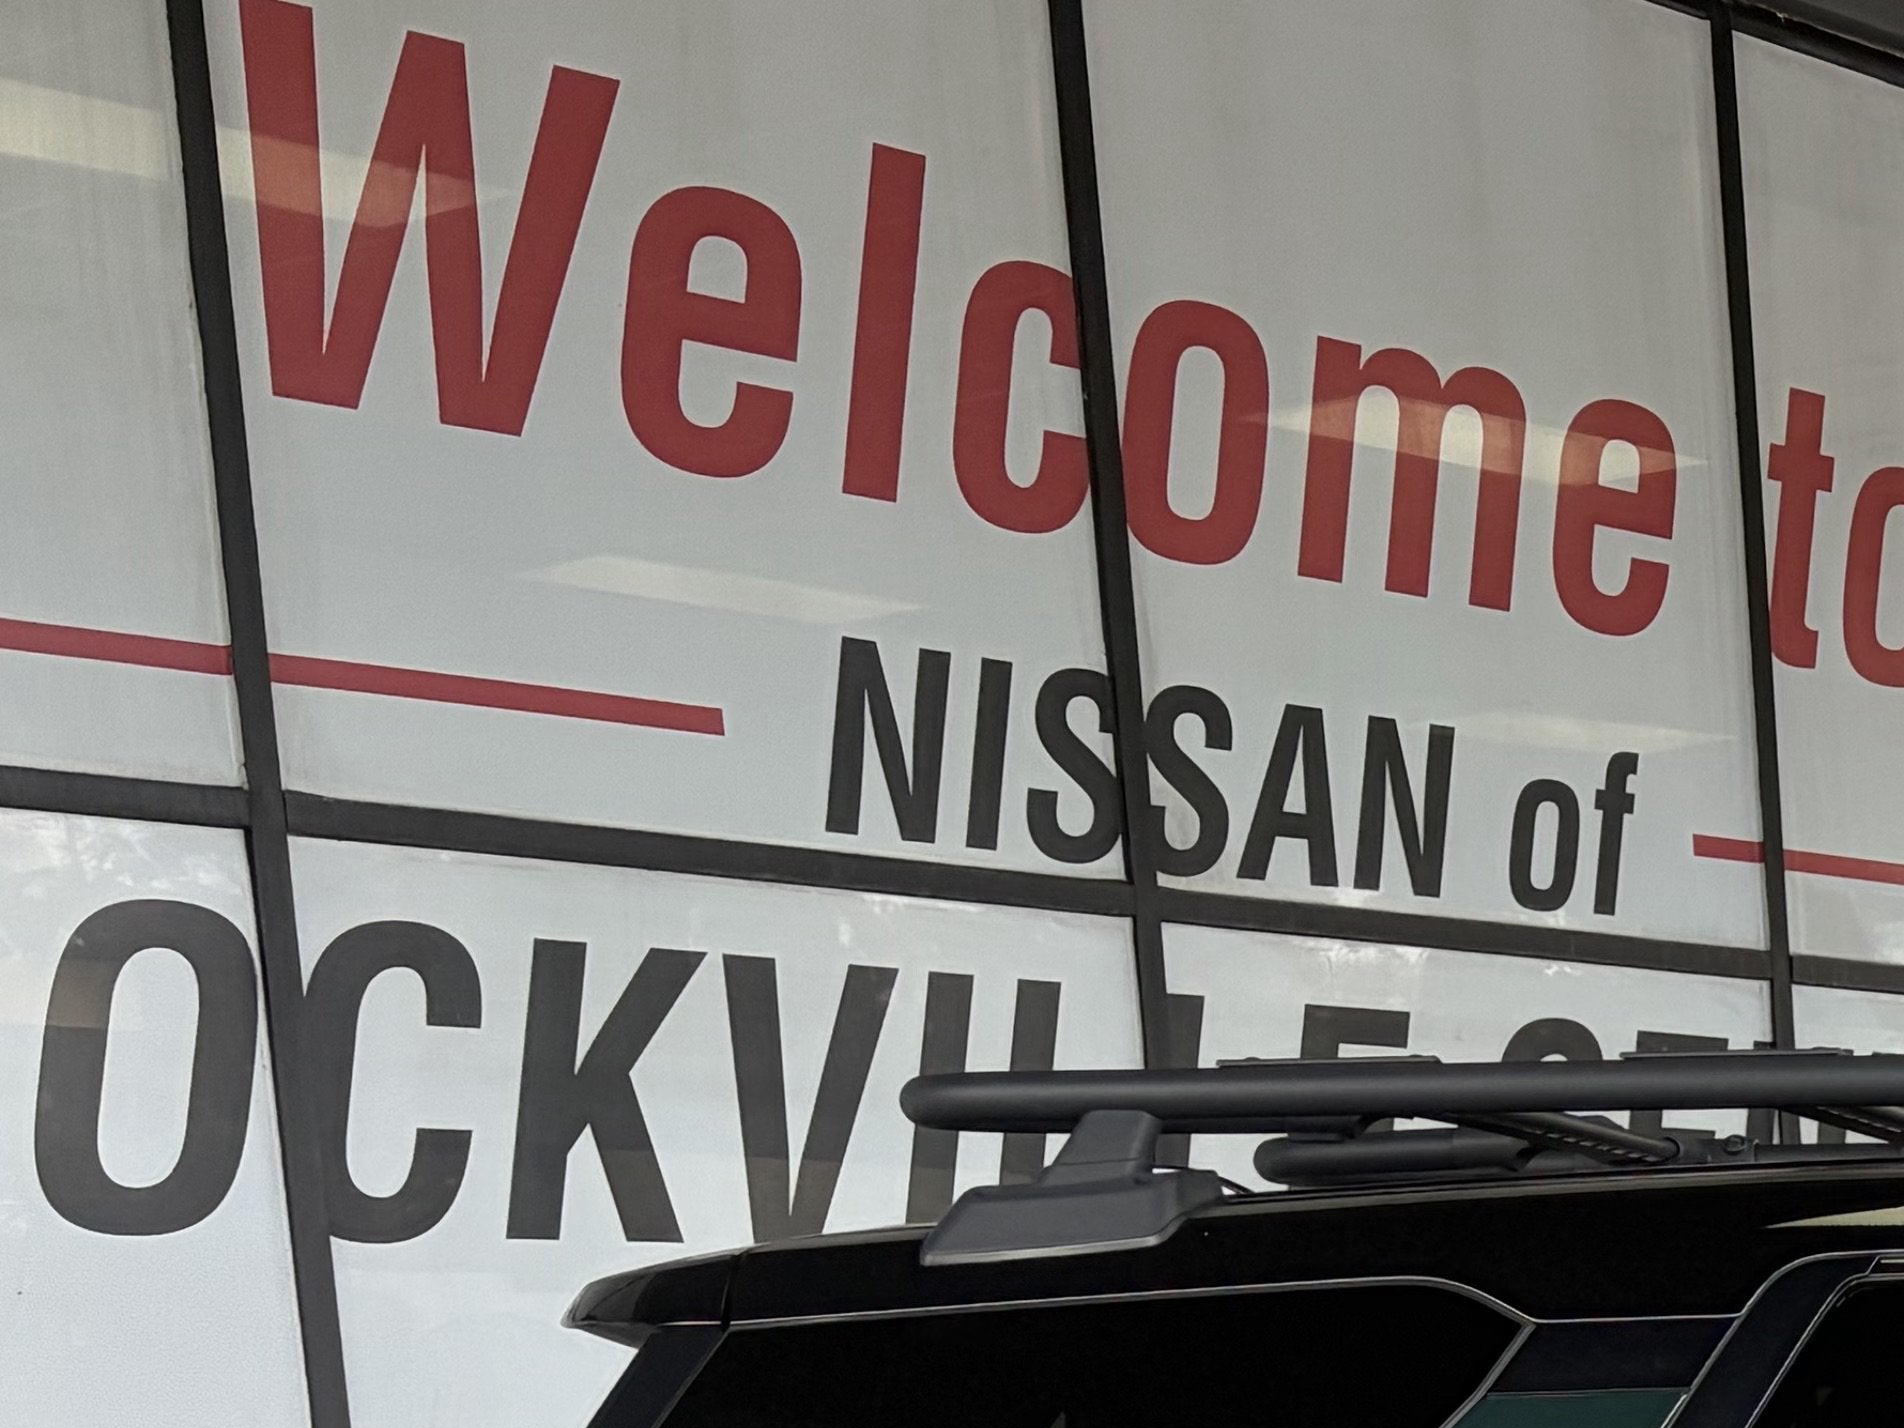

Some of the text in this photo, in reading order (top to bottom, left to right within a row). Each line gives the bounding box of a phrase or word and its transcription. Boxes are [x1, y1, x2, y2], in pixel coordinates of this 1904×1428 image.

[239, 0, 1678, 637] Welcome
[825, 635, 1639, 917] NISSAN of
